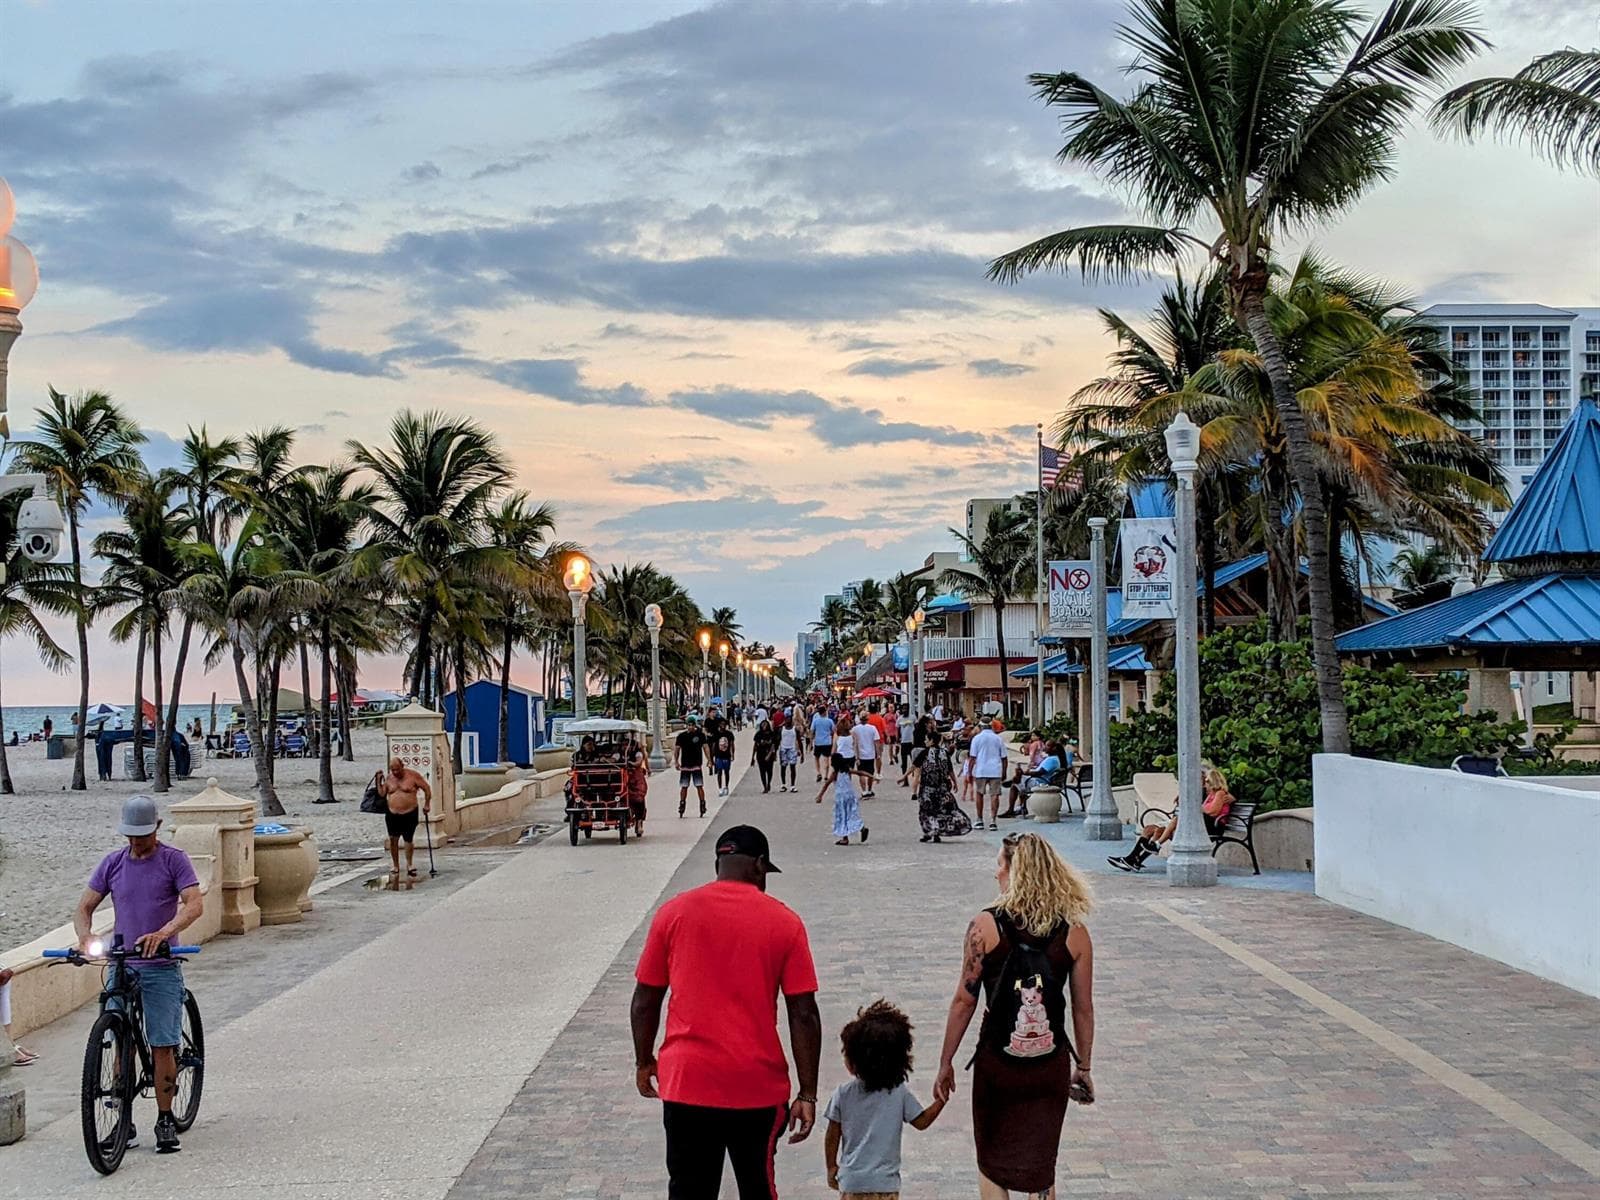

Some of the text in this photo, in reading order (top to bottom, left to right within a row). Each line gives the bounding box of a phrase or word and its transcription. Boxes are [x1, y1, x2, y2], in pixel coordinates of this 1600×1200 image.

[1143, 584, 1169, 592] LITTERING
[1051, 591, 1092, 606] SKATE
[1051, 605, 1092, 617] BOARDS
